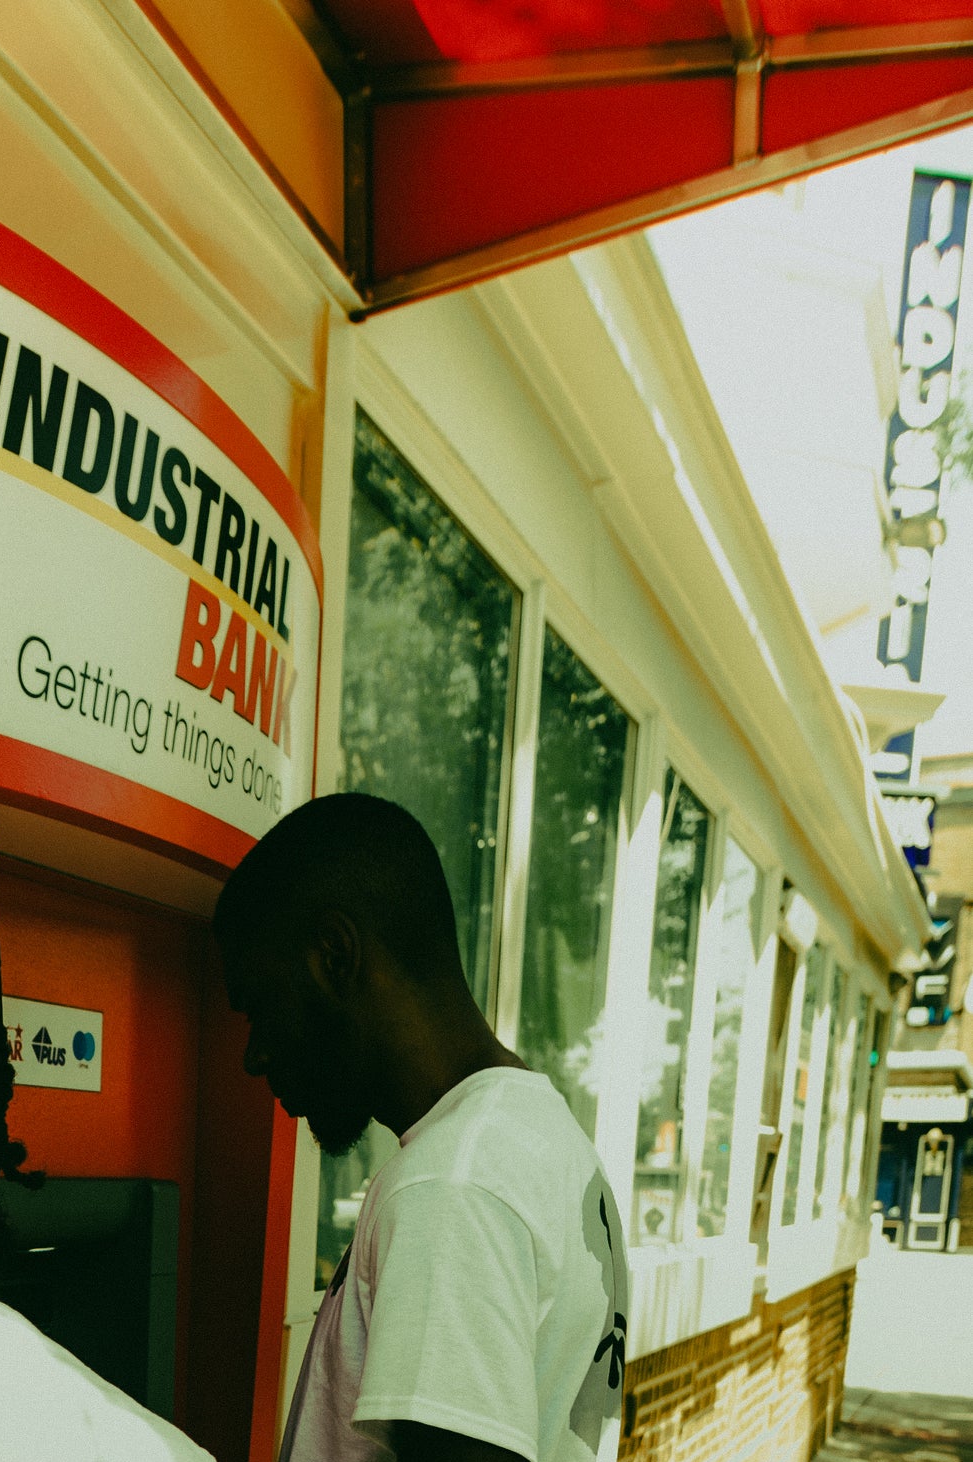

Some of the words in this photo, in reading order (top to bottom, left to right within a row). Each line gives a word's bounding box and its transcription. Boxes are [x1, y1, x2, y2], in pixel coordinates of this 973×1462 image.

[17, 635, 151, 755] Getting
[164, 700, 236, 789] things
[242, 749, 283, 816] done
[175, 578, 298, 759] BANK
[40, 1046, 66, 1066] PLUS
